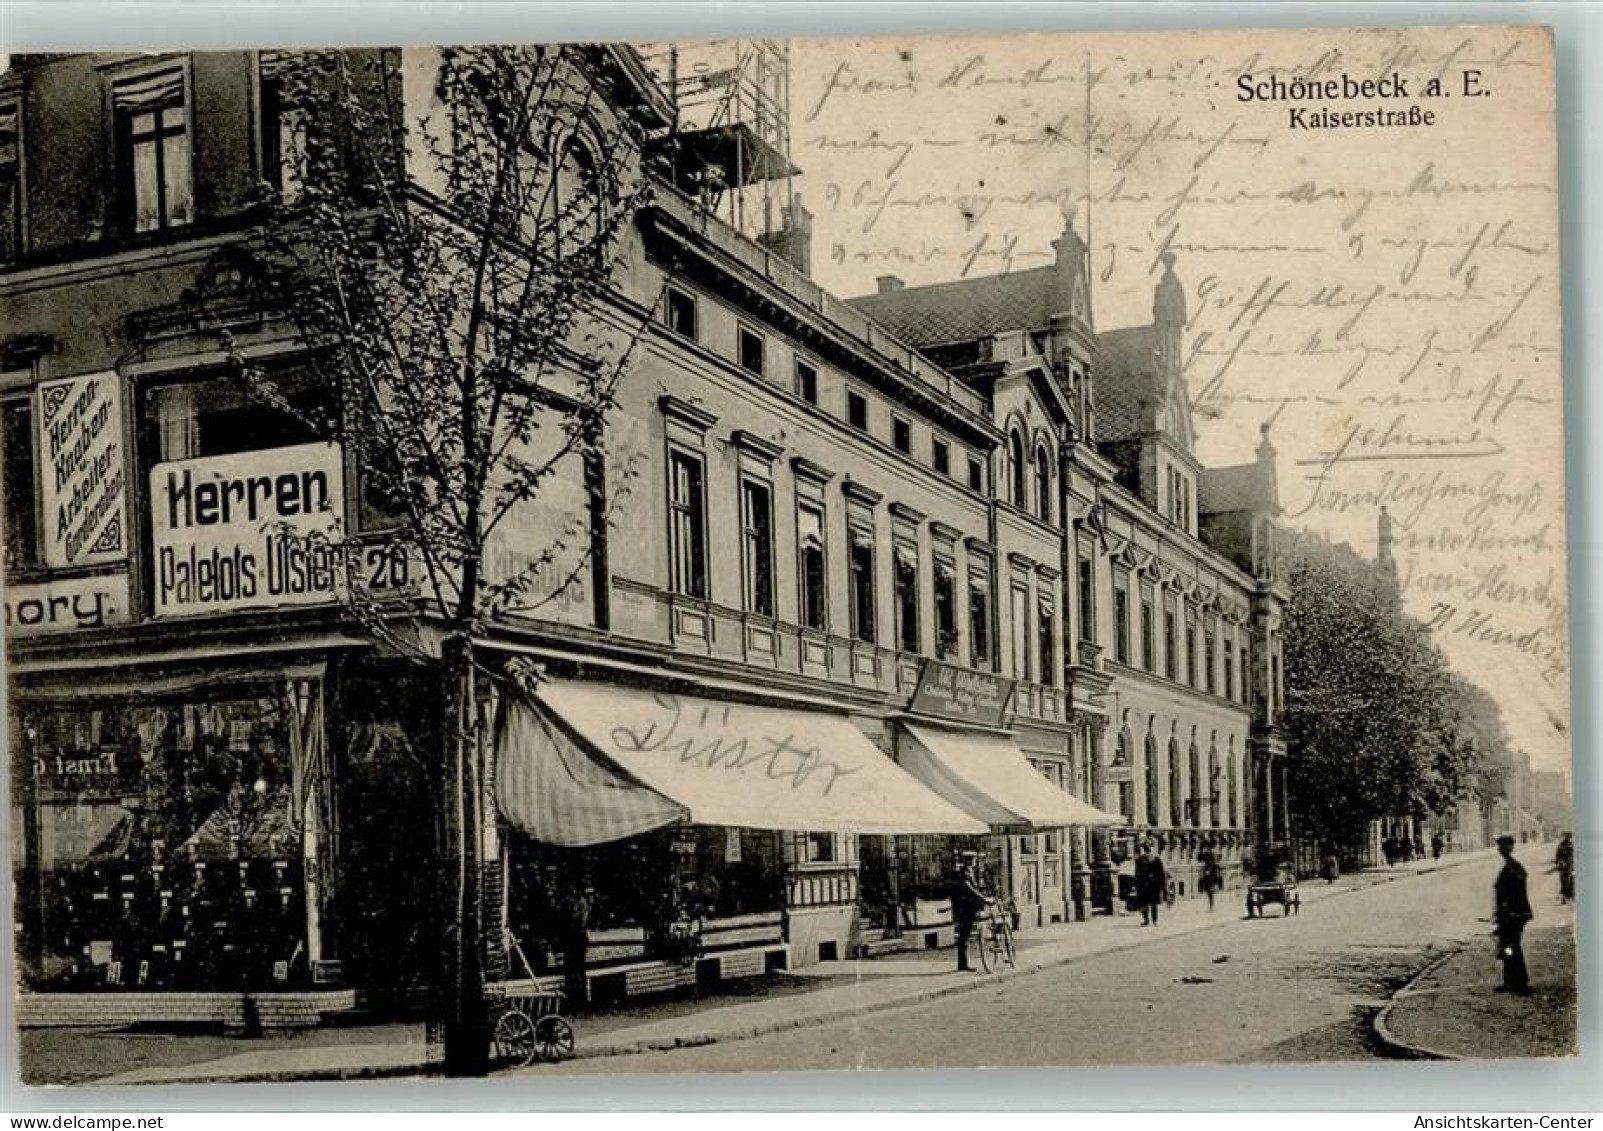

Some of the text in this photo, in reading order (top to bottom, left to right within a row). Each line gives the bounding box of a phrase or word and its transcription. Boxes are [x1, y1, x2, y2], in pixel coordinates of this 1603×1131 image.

[50, 379, 100, 460] Herren-
[55, 399, 114, 495] Knaben-
[167, 468, 329, 530] Herren
[159, 543, 257, 606] Paletots
